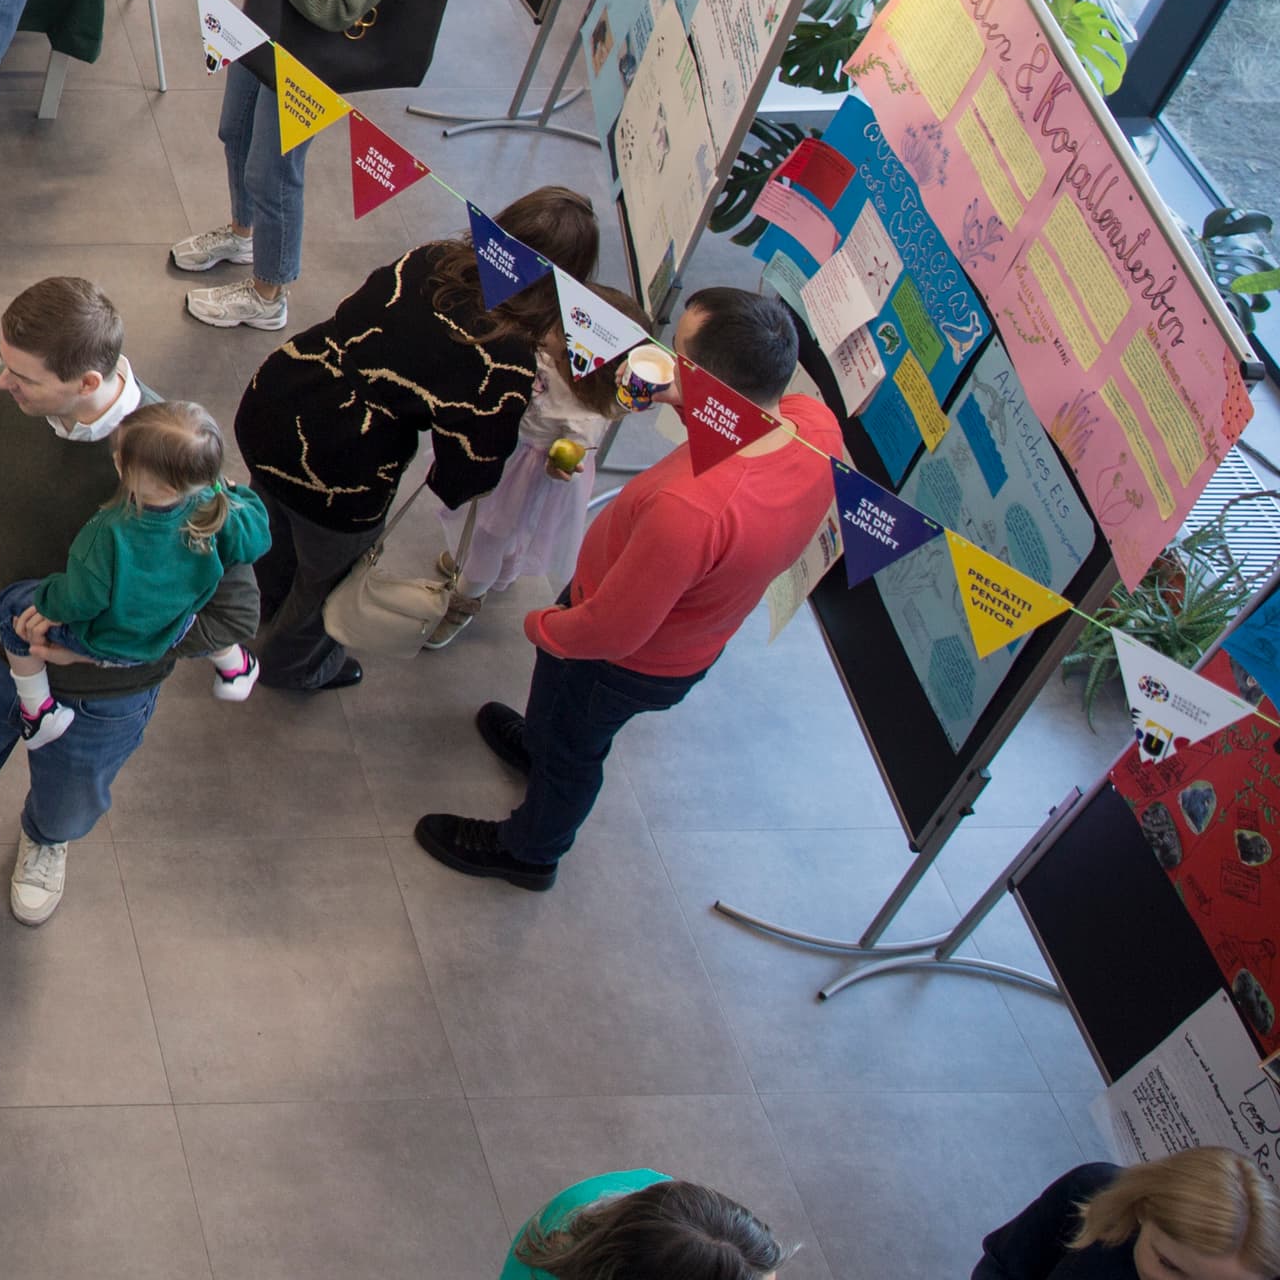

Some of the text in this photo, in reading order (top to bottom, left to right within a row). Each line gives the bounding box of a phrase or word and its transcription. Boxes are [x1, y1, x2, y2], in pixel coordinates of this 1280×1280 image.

[284, 102, 312, 129] VIITOR
[285, 90, 318, 121] PENTRU
[368, 147, 395, 172] STARK
[377, 165, 392, 179] DIE
[355, 157, 396, 192] ZUKUNFT
[478, 247, 520, 283] ZUKUNFT
[488, 238, 516, 264] STARK
[498, 256, 513, 271] DIE
[706, 396, 740, 424] STARK
[719, 415, 736, 432] DIE
[692, 407, 742, 446] ZUKUNFT
[993, 370, 1051, 482] Arktisches
[1050, 483, 1071, 519] Eis
[859, 498, 896, 527] STARK
[872, 517, 892, 535] DIE
[843, 510, 900, 550] ZUKUNFT
[970, 597, 1014, 628] VIITOR
[971, 583, 1021, 619] PENTRU
